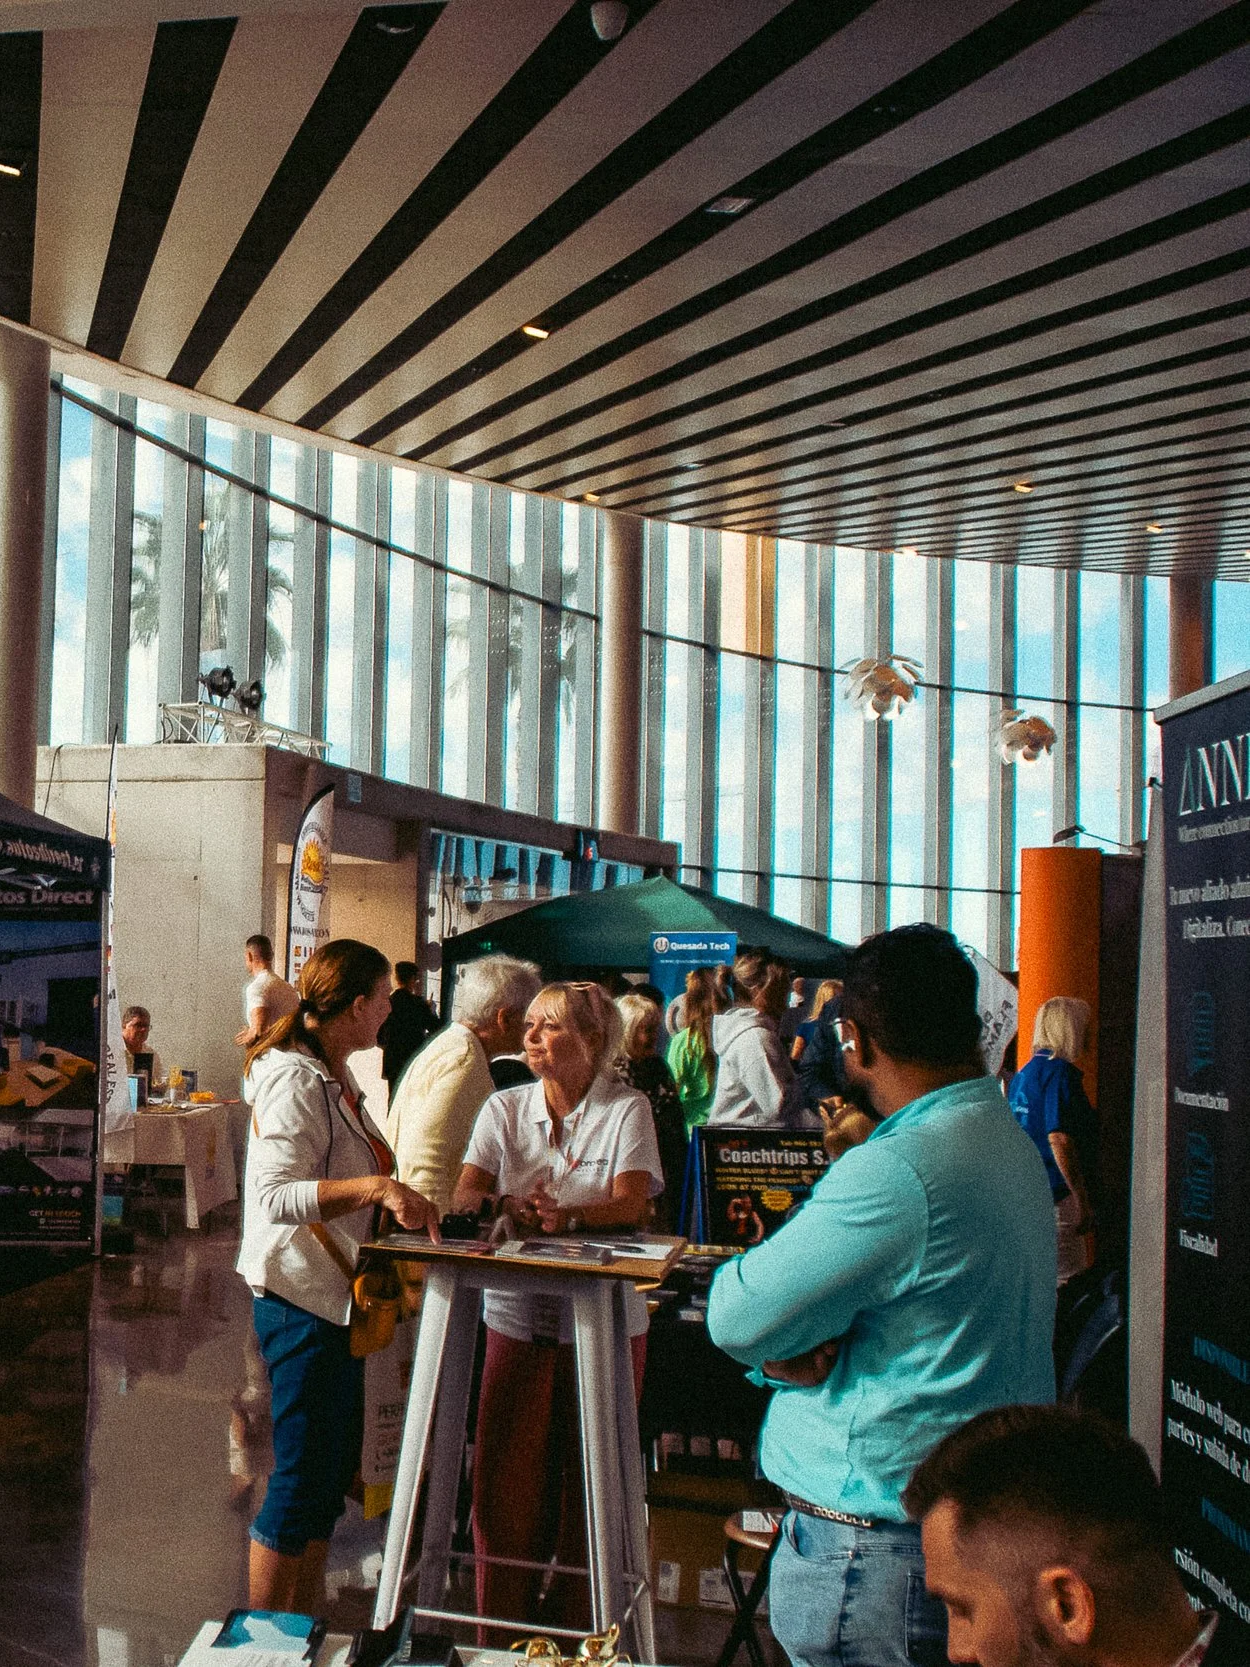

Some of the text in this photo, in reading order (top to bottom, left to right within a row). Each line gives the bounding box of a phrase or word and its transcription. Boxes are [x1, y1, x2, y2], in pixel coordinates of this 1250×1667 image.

[1179, 732, 1250, 817] ANN
[31, 889, 94, 904] Direct
[670, 942, 730, 951] Quesada Tech
[719, 1148, 809, 1166] Coachtrips
[1175, 1547, 1200, 1580] rsión
